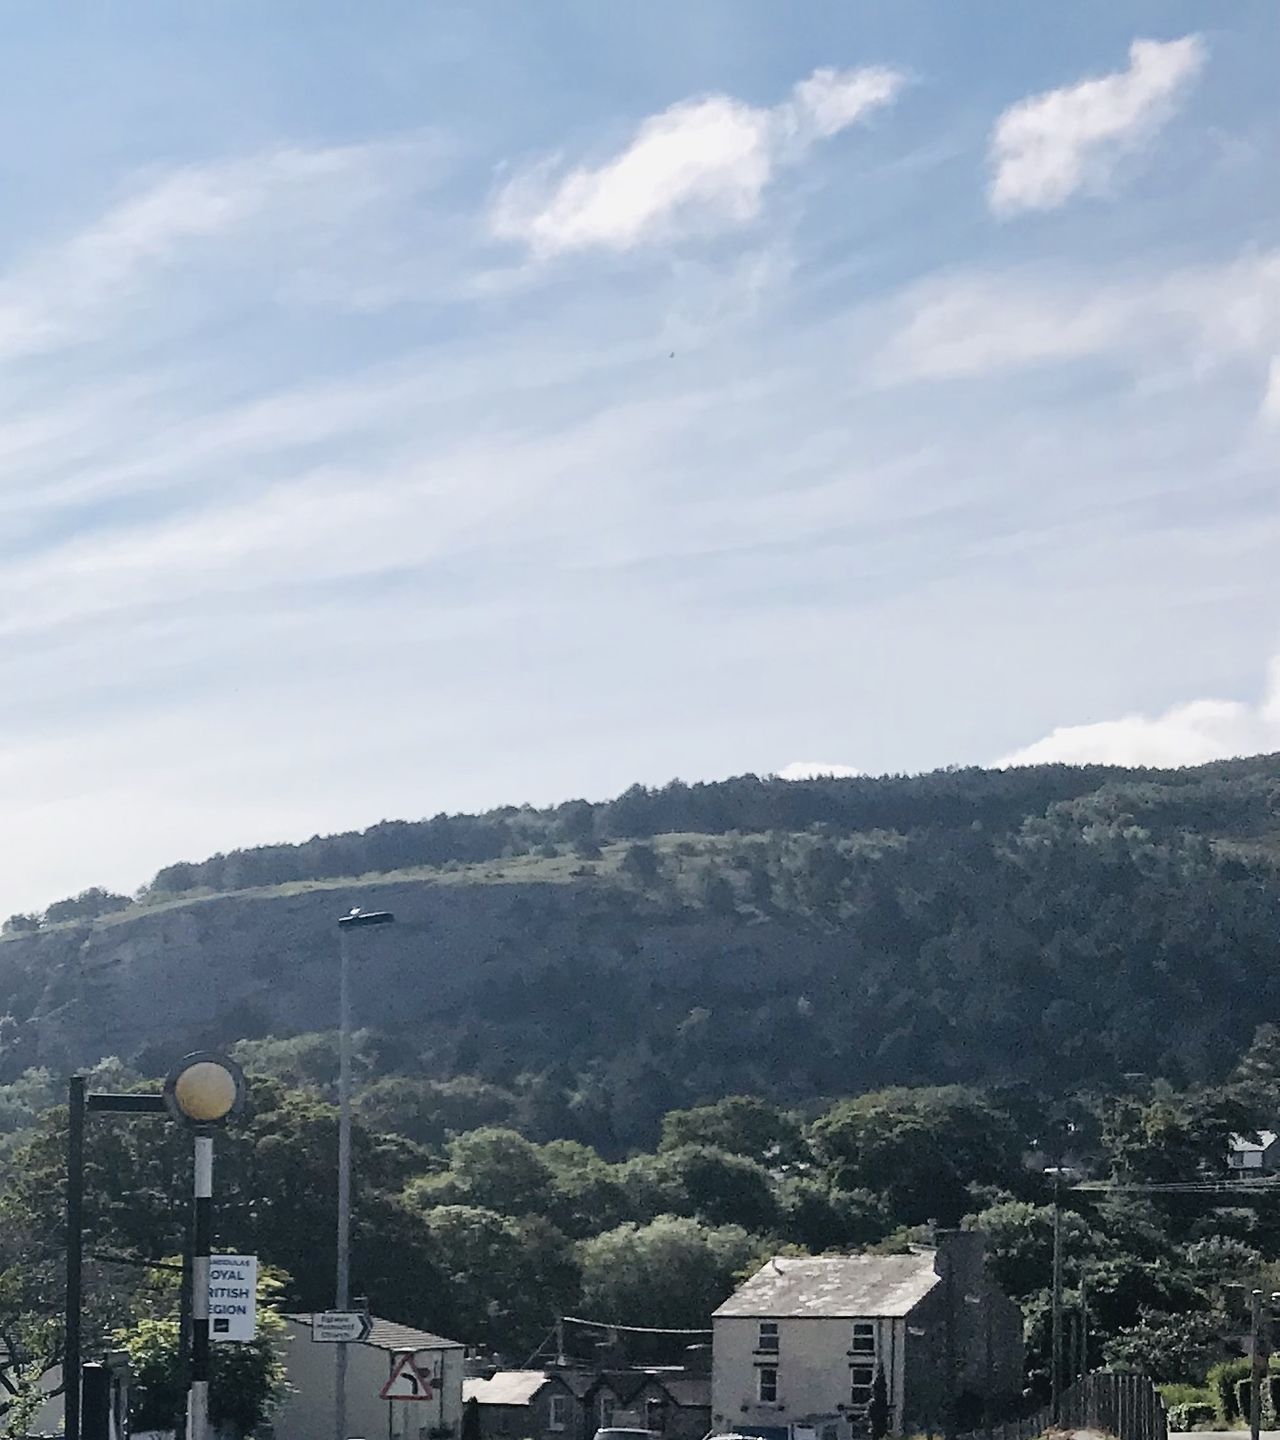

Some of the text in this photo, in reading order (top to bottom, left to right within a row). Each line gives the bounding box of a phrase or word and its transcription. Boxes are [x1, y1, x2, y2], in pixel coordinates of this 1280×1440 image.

[209, 1270, 245, 1281] OYAL
[209, 1287, 249, 1299] RITISH
[209, 1304, 247, 1315] EGION
